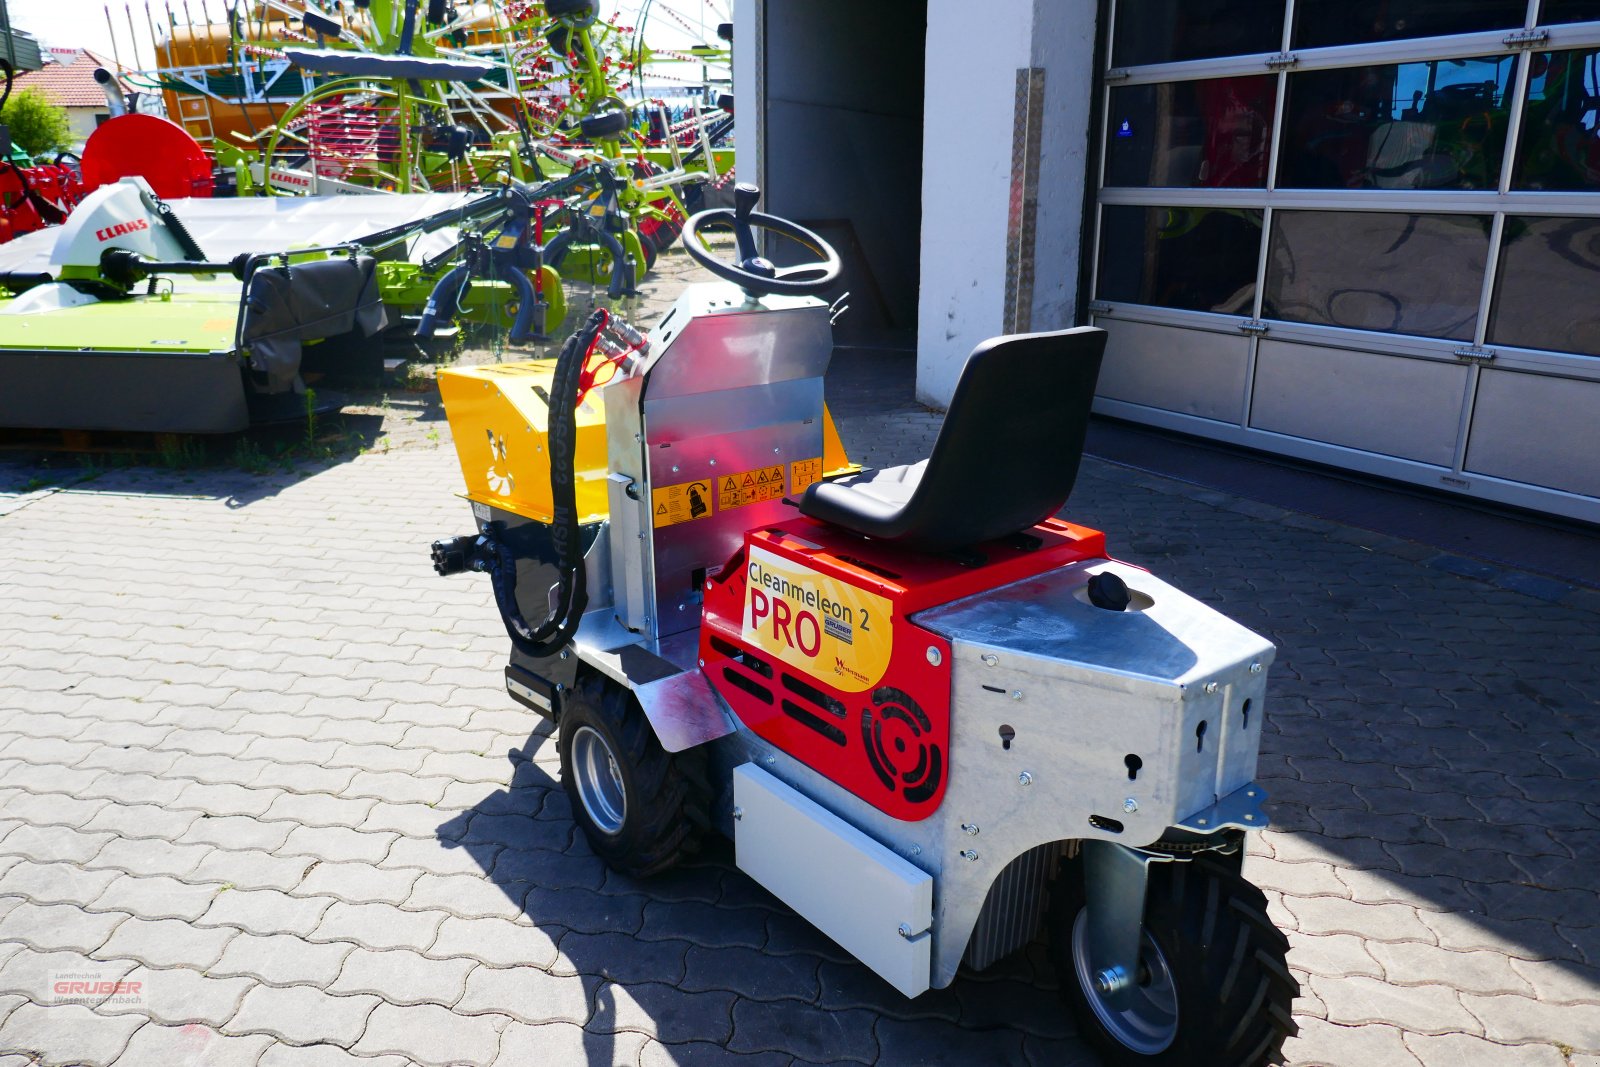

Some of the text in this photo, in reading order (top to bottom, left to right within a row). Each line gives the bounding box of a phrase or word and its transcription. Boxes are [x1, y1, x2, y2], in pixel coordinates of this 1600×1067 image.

[271, 172, 310, 187] CLAAS
[95, 218, 149, 242] CLAAS
[749, 562, 870, 632] Cleanmeleon 2
[751, 587, 822, 658] PRO
[824, 619, 852, 635] GRUBER
